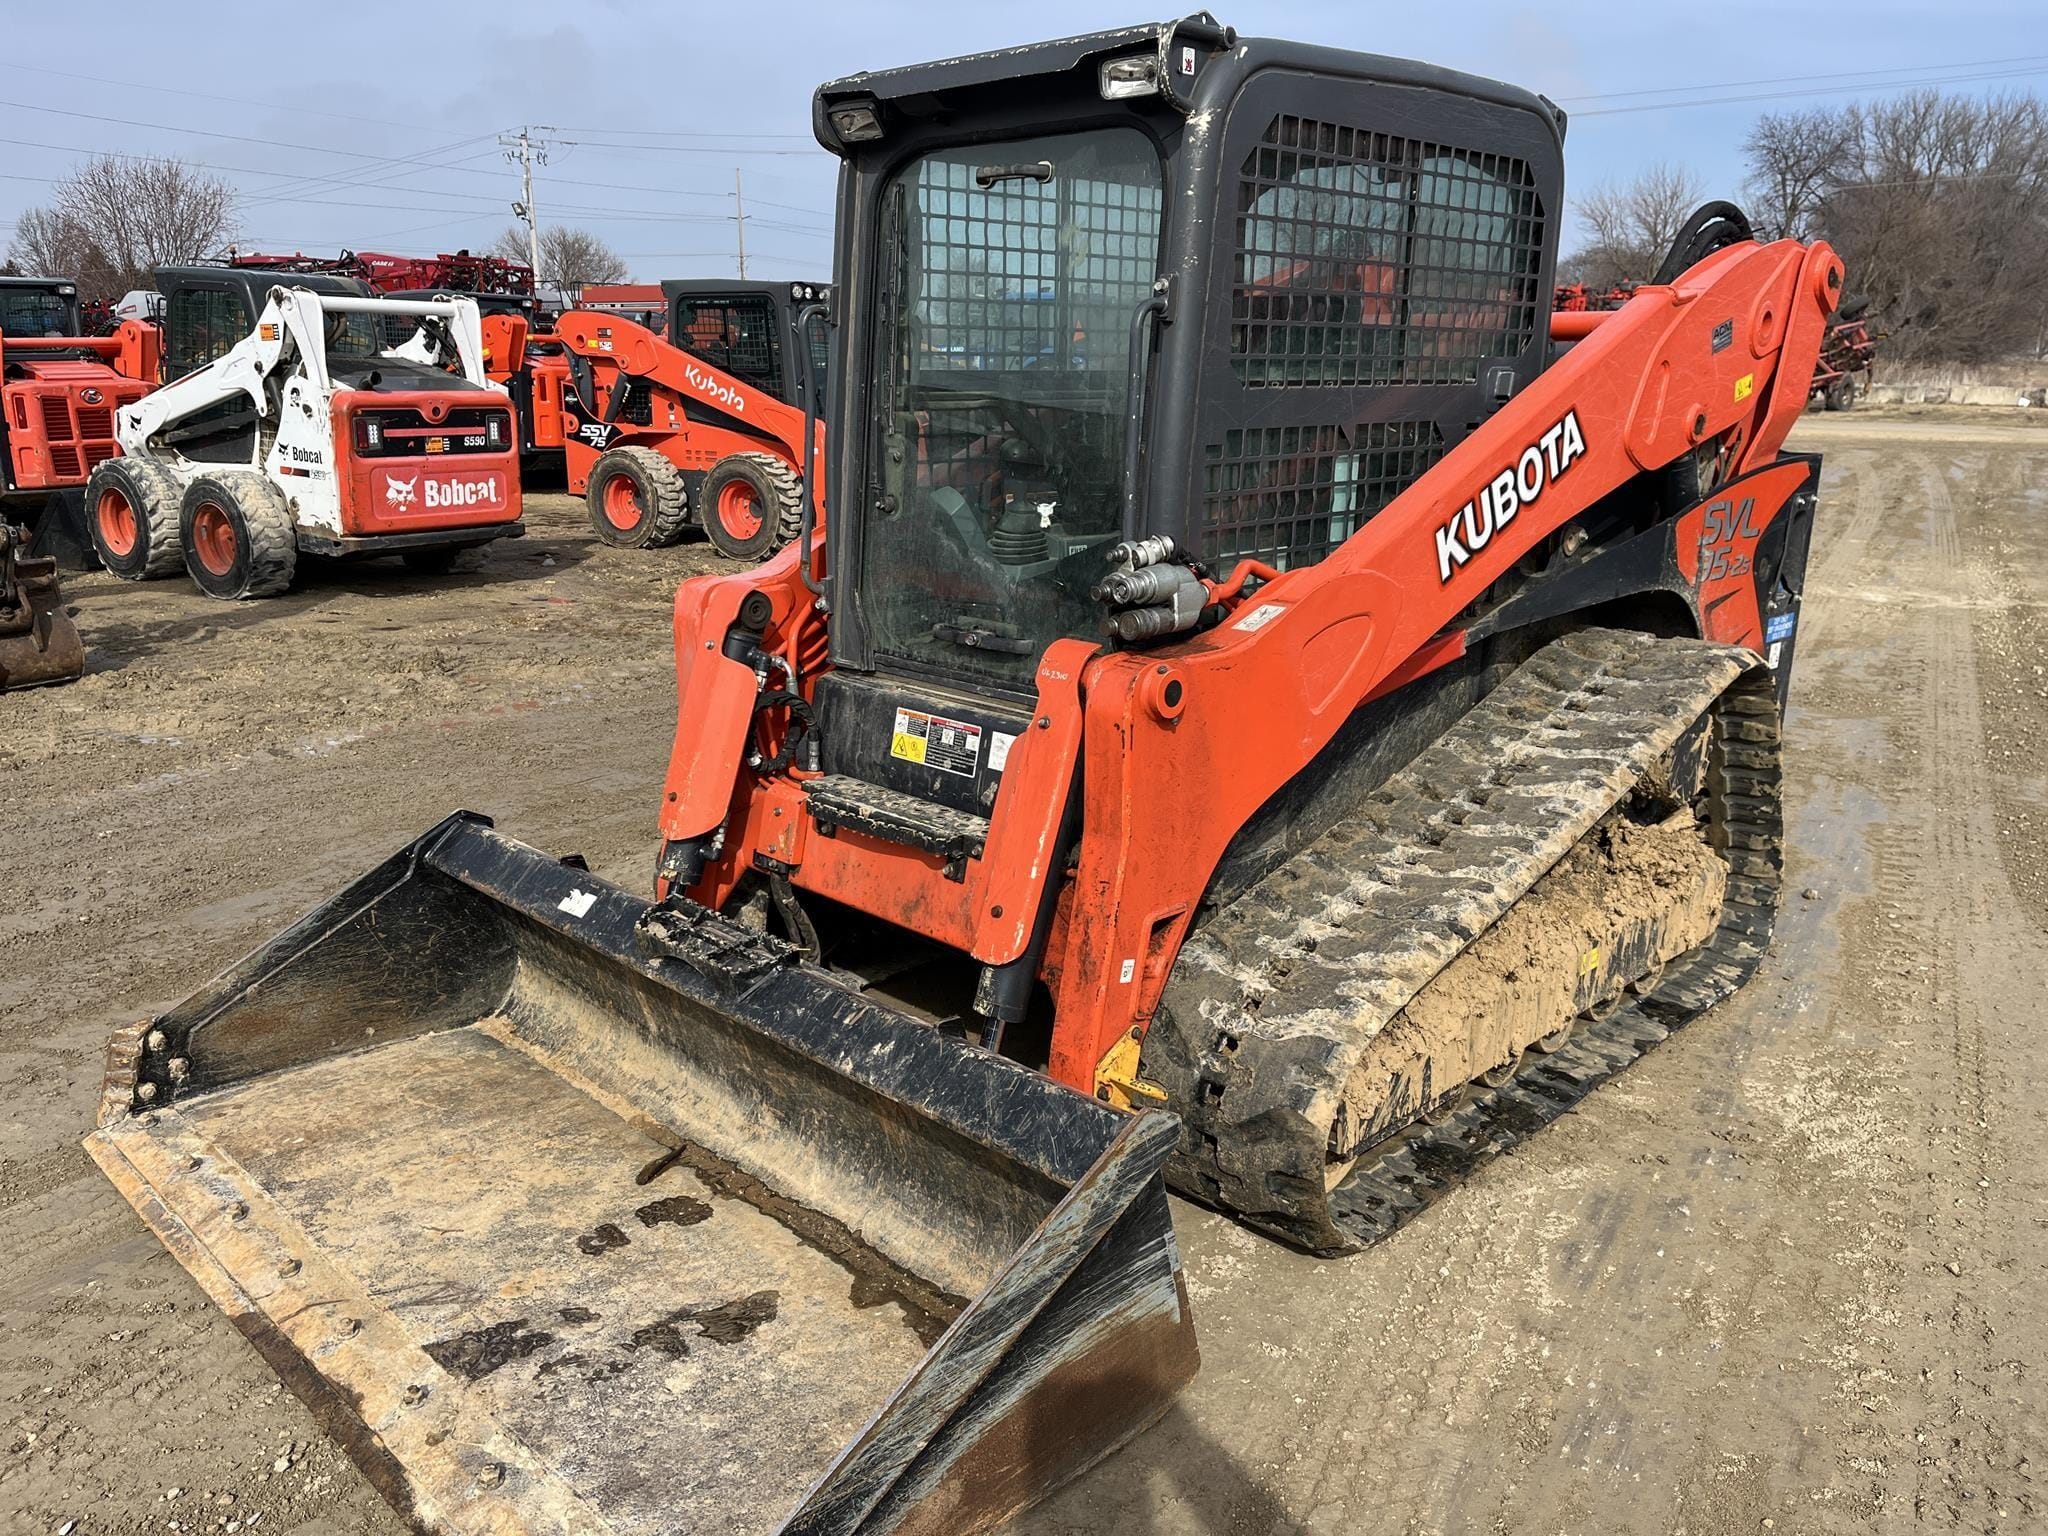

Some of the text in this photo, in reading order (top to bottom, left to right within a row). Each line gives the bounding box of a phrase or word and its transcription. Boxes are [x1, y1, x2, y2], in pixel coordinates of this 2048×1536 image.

[685, 363, 745, 412] Kubota
[463, 436, 486, 446] S590
[580, 424, 612, 437] SSV
[590, 437, 607, 447] 75
[292, 446, 323, 465] Bobcat
[423, 477, 497, 508] Bobcat
[1435, 411, 1585, 582] KUBOTA
[1697, 497, 1760, 546] SVL
